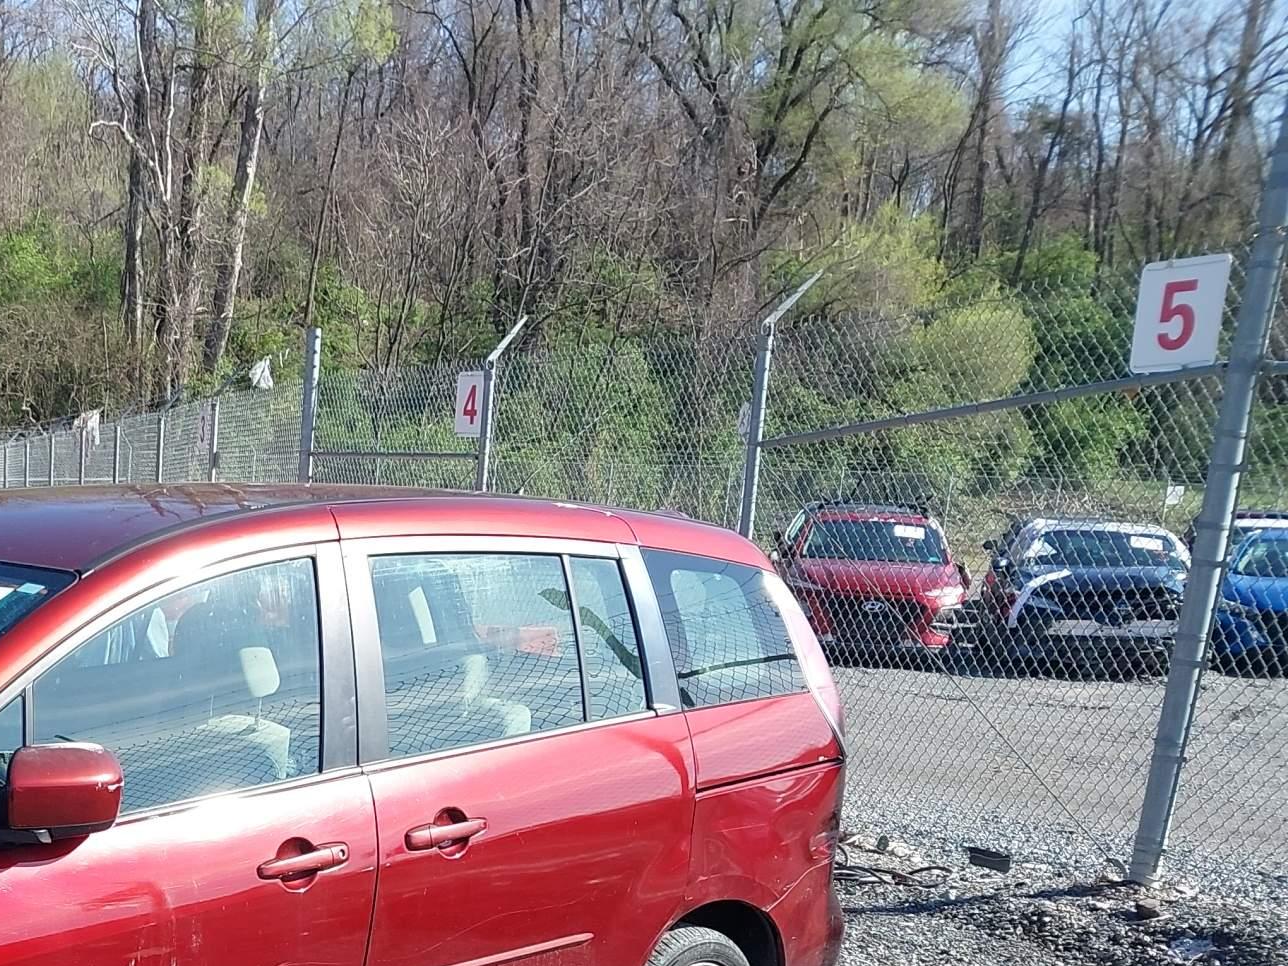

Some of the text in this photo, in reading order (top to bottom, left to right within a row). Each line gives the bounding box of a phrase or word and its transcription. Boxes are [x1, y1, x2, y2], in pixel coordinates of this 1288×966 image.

[1157, 279, 1199, 351] 5
[463, 384, 478, 425] 4
[200, 415, 206, 443] 3
